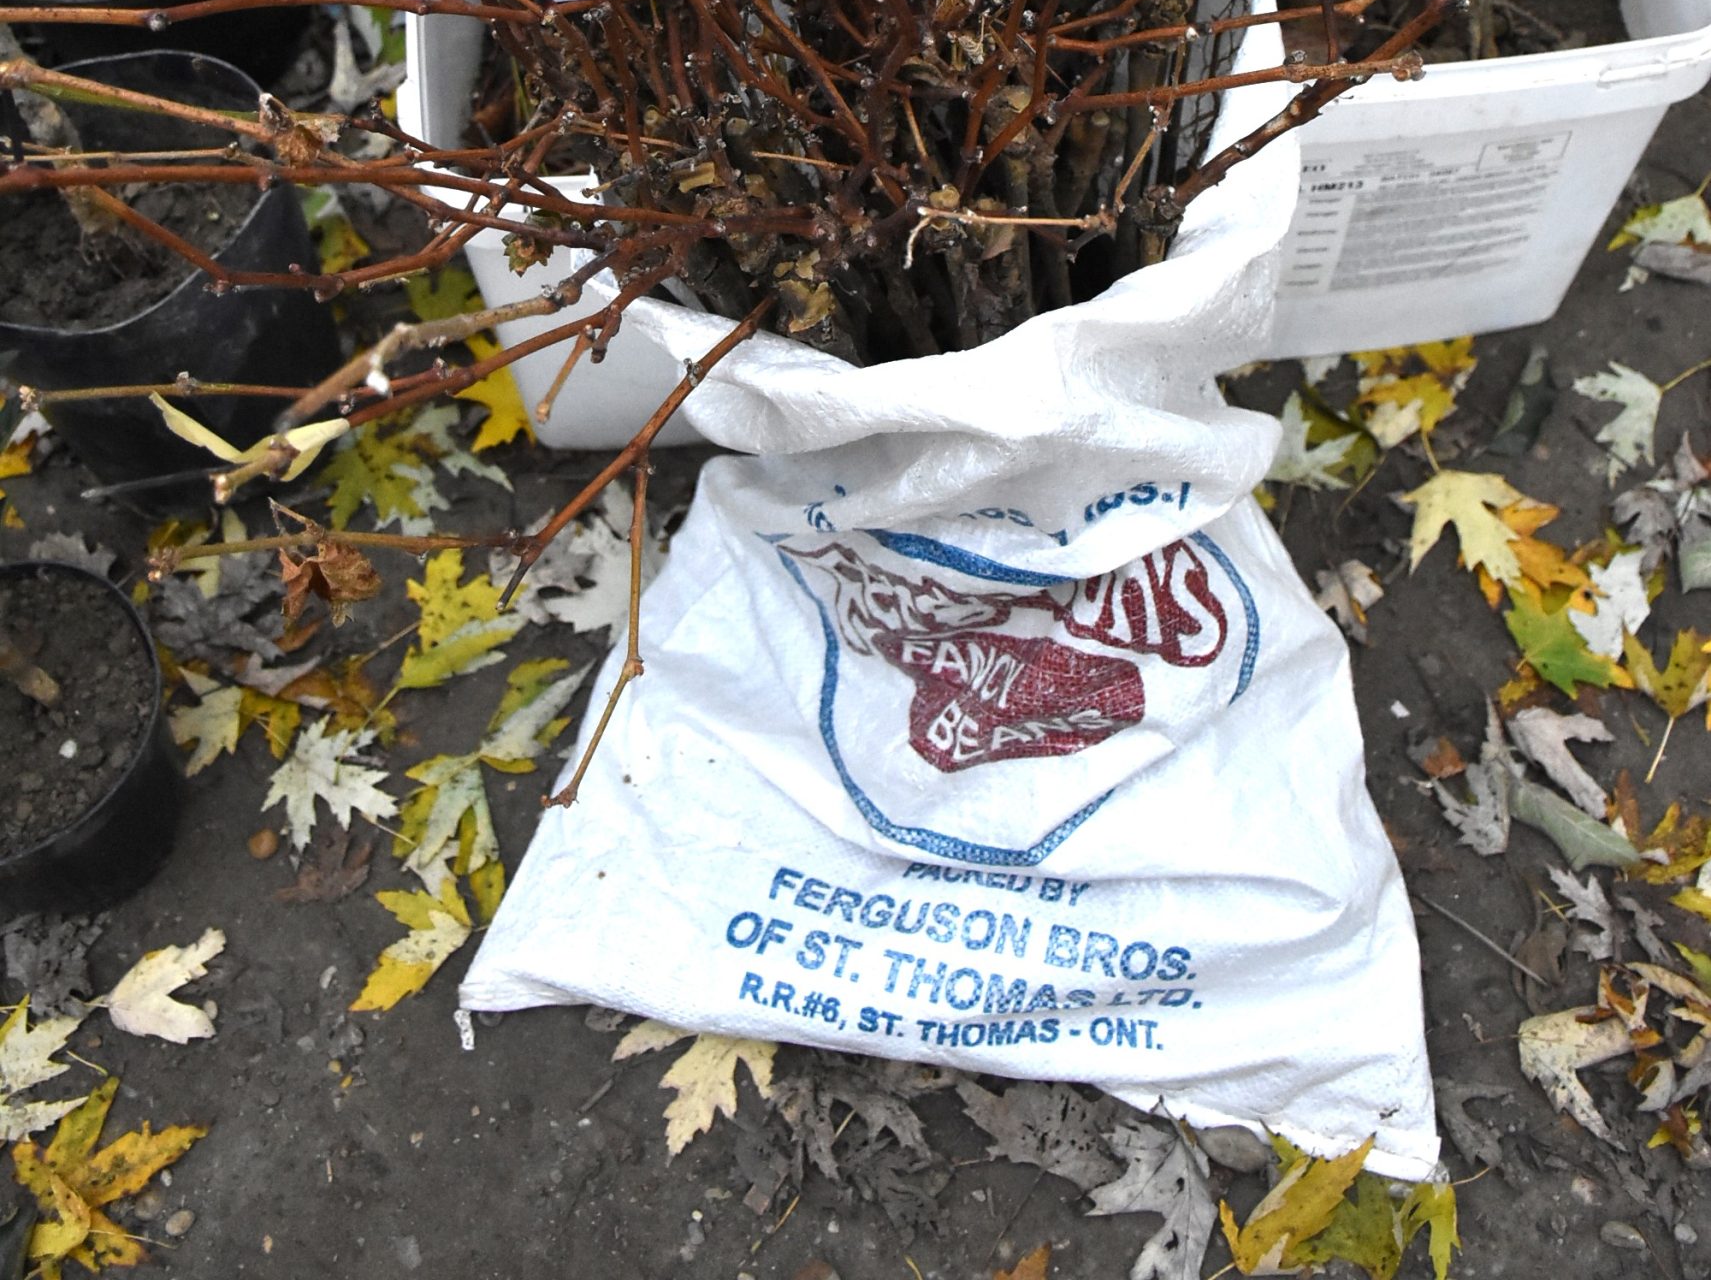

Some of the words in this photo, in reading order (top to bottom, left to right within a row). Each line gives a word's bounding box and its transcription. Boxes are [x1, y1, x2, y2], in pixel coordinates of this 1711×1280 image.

[902, 639, 1027, 709] FANCY
[925, 698, 1114, 763] BEANS
[768, 866, 1033, 960] FERGUSON
[1043, 923, 1198, 982] BROS.
[1038, 876, 1092, 907] BY
[725, 910, 794, 955] OF
[795, 929, 865, 983] ST.
[883, 948, 1097, 1015] THOMAS
[1105, 987, 1203, 1010] LTD.
[857, 1006, 905, 1038] ST.
[915, 1017, 1062, 1048] THOMAS
[1088, 1016, 1165, 1051] ONT.
